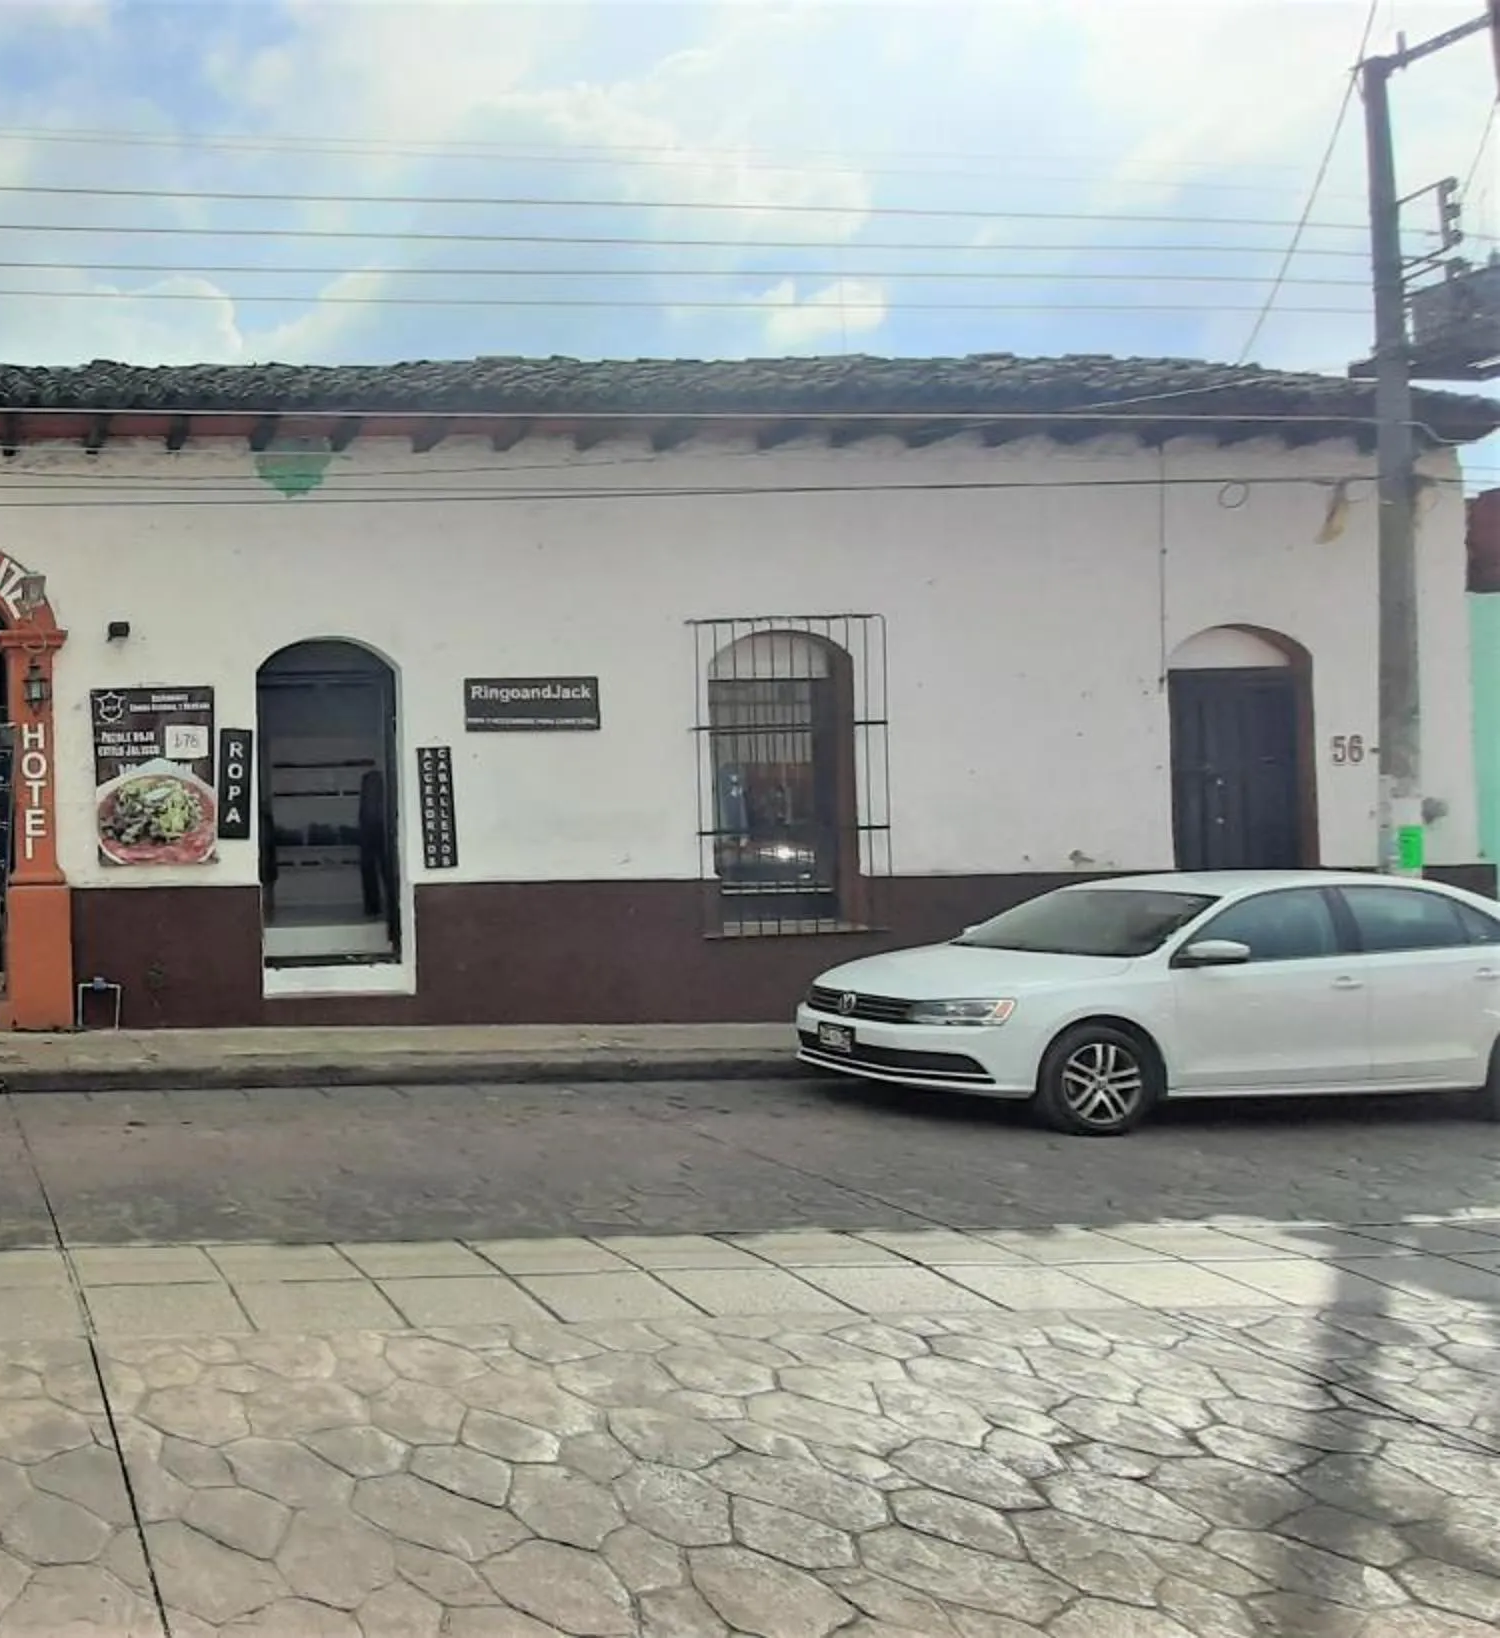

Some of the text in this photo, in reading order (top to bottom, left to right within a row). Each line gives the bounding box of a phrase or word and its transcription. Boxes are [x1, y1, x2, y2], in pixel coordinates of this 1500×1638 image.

[471, 684, 592, 703] RingoandJack
[1332, 735, 1364, 763] 56
[226, 742, 244, 823] ROPA
